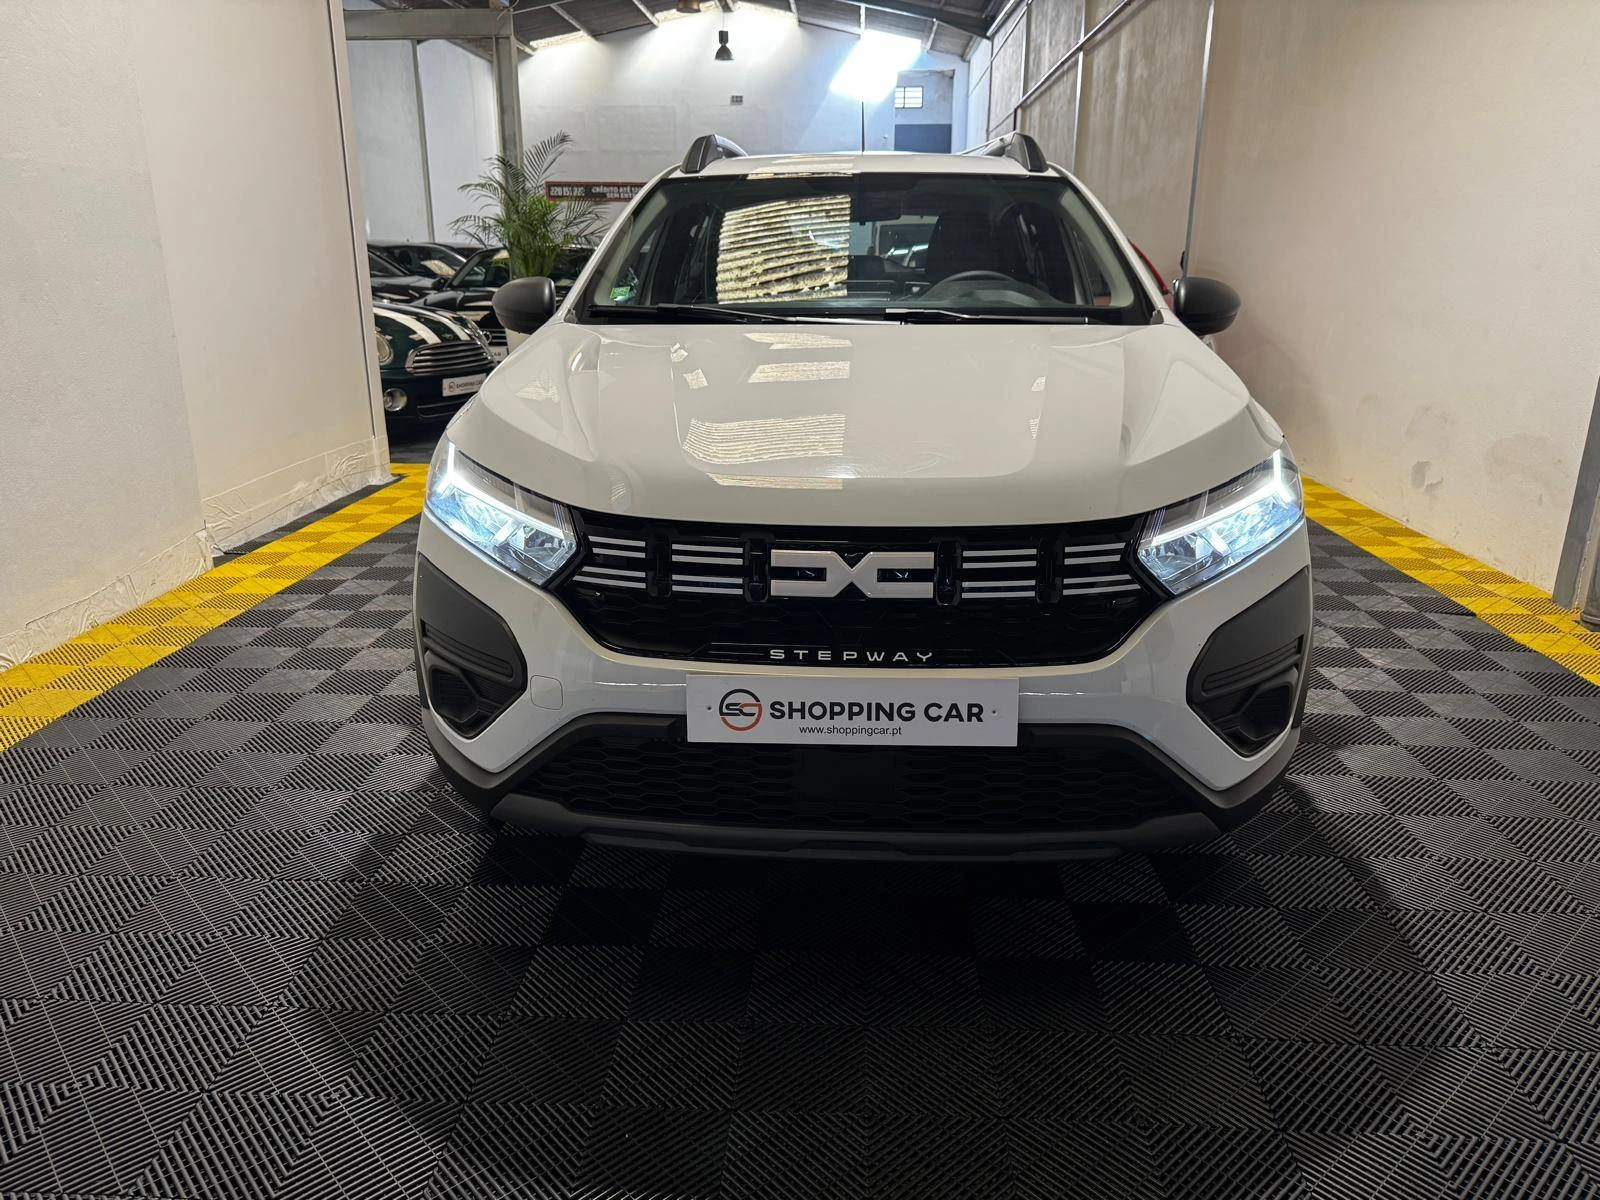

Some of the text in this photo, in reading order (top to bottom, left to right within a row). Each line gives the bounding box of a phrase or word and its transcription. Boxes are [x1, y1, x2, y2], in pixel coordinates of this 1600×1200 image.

[770, 650, 932, 662] STEPWAY
[769, 701, 916, 722] SHOPPING
[924, 702, 984, 722] CAR
[799, 725, 902, 737] www.shoppingcar.pt
